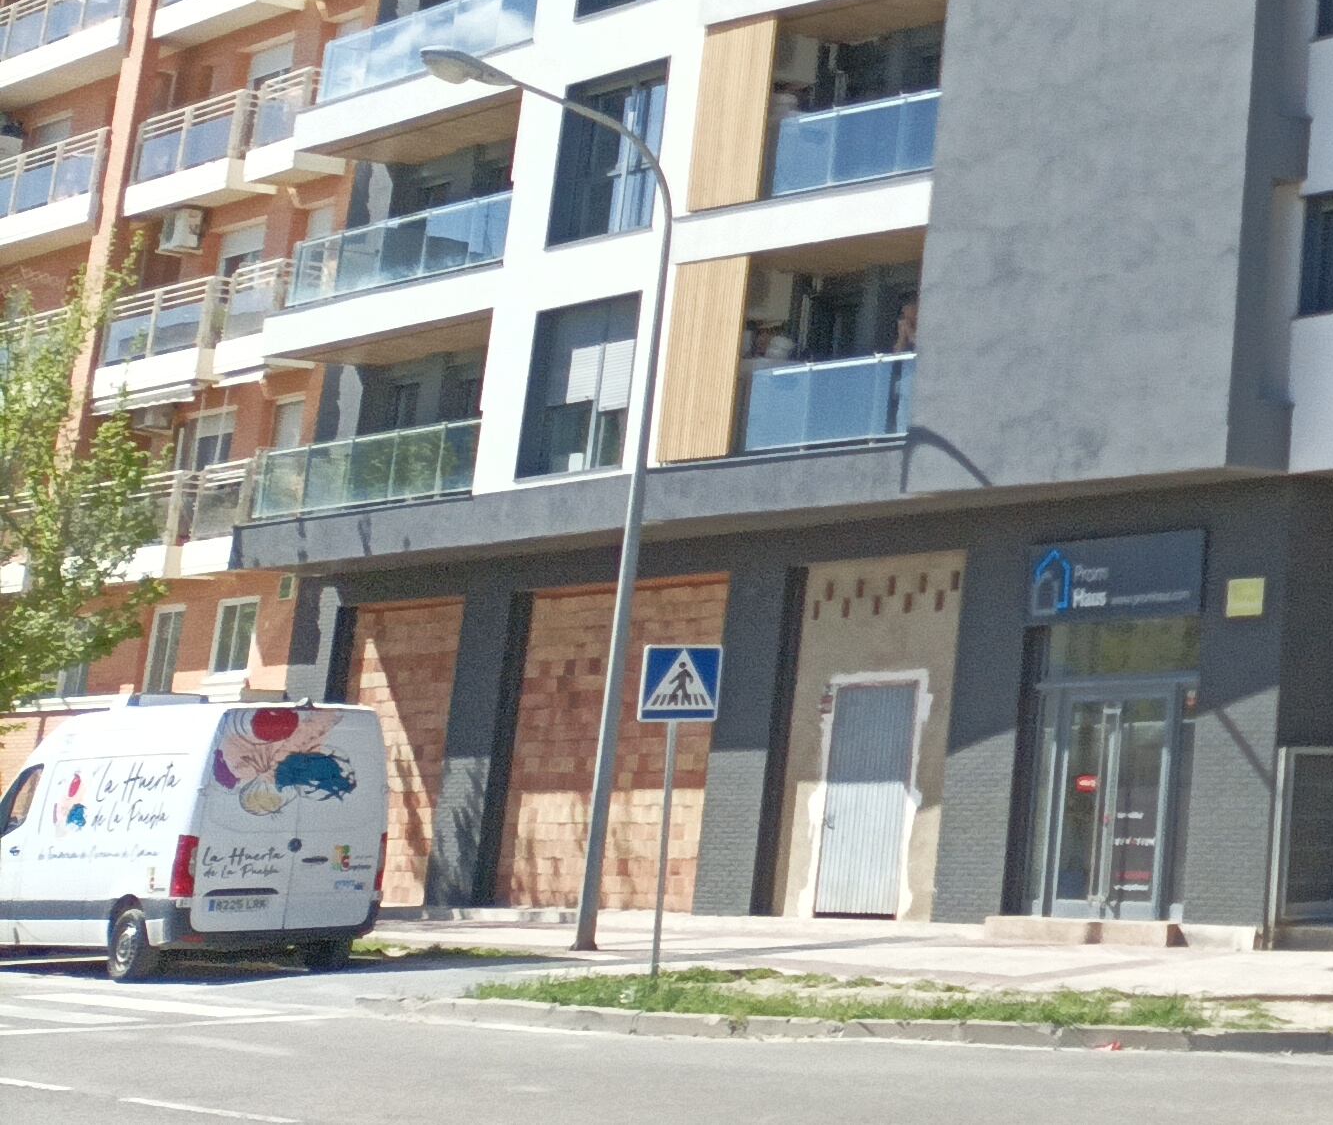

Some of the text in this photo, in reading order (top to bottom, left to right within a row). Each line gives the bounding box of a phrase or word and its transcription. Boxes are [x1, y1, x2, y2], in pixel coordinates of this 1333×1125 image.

[1073, 588, 1107, 608] Haus
[96, 760, 181, 803] La Huerta
[202, 846, 286, 866] La Huerta
[203, 867, 217, 878] de
[221, 864, 237, 879] La
